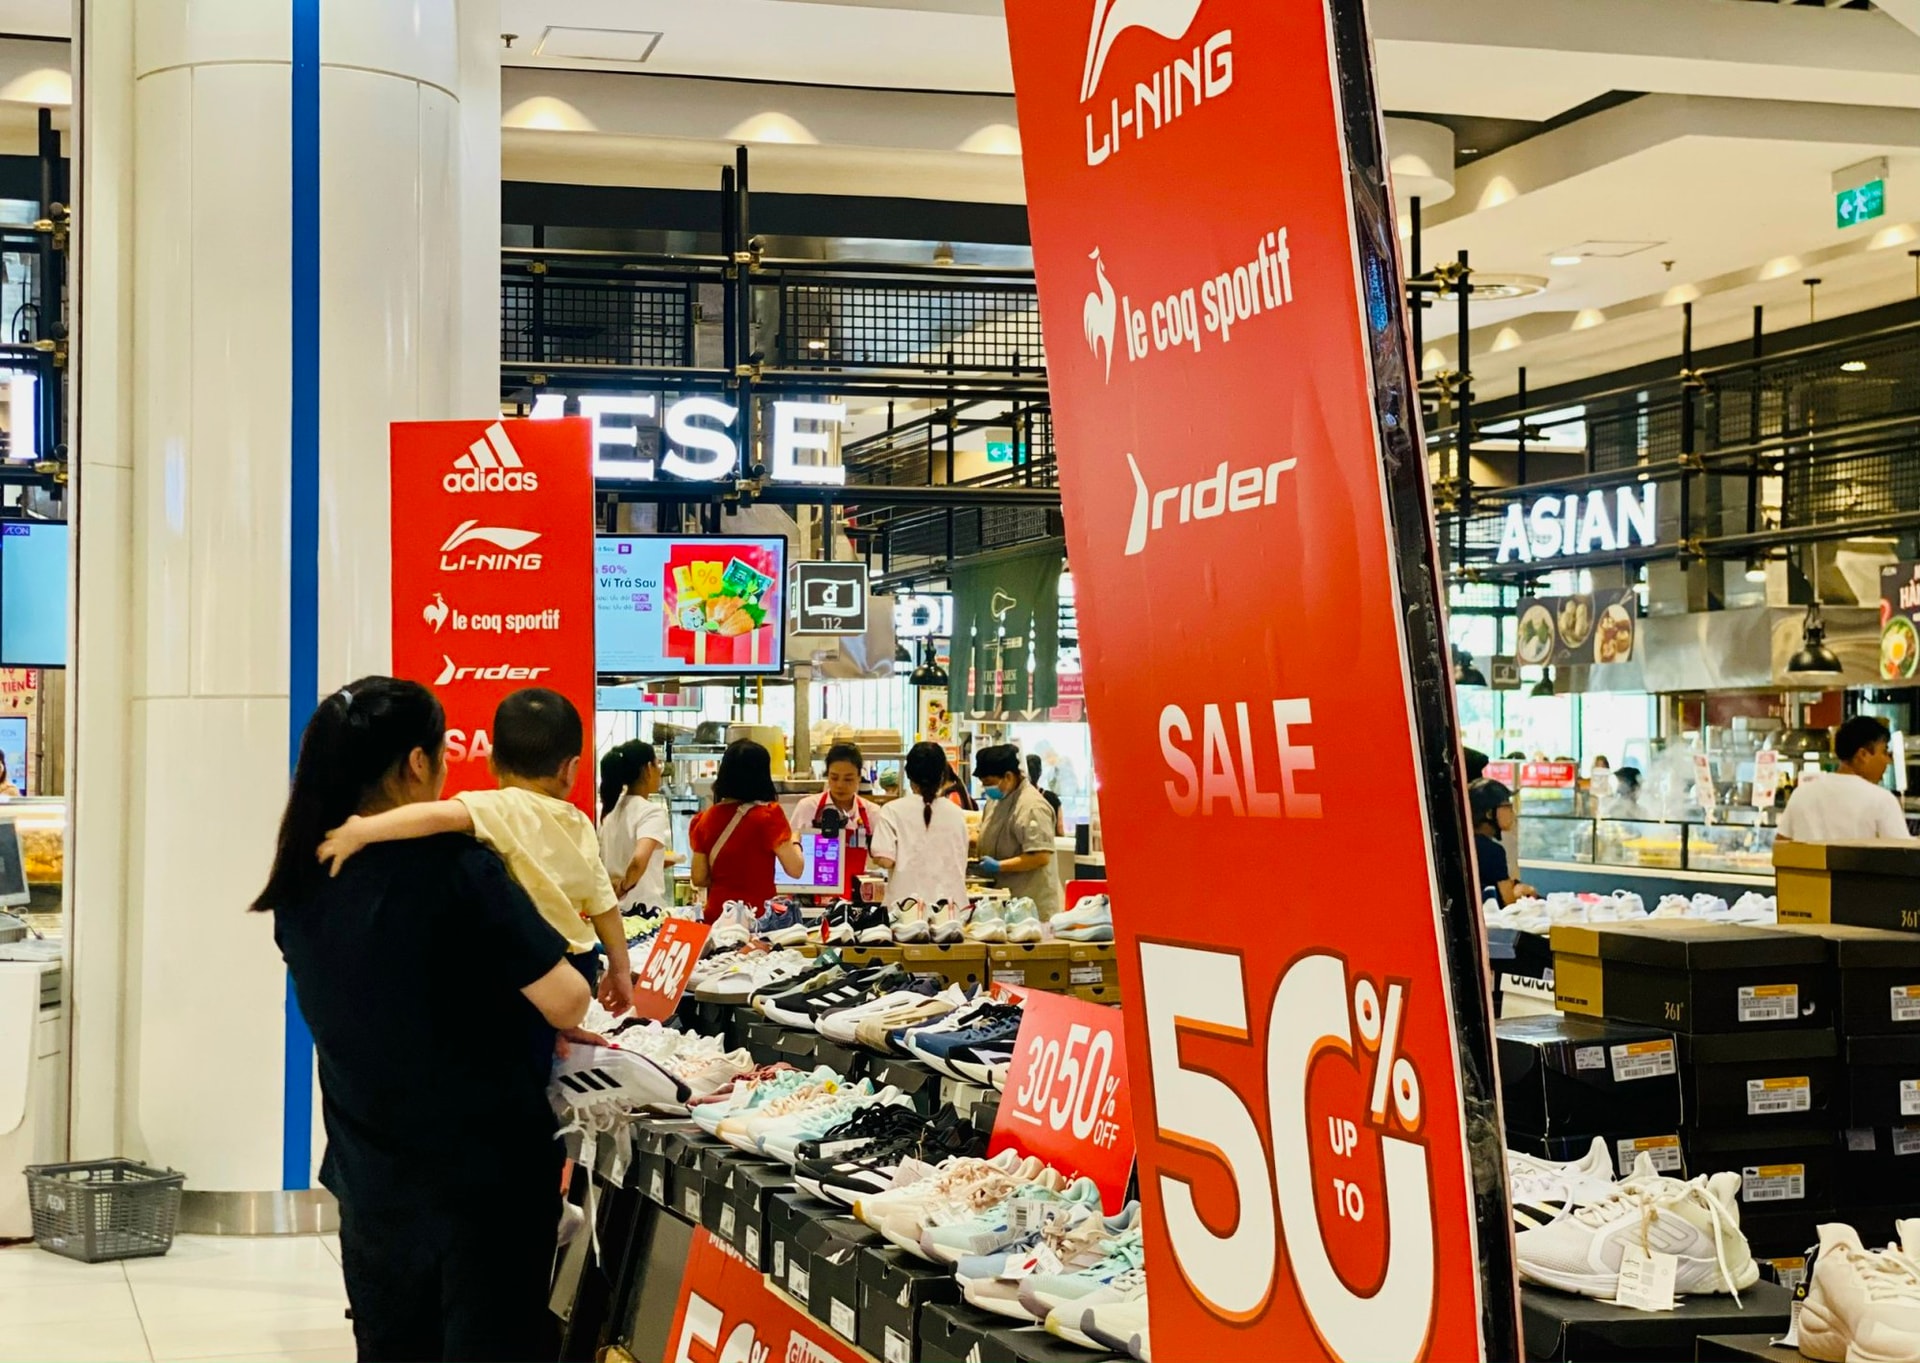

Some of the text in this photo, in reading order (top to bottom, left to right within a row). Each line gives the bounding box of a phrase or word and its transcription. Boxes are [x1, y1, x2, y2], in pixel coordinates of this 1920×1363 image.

[1086, 29, 1232, 166] LI-NING
[1122, 226, 1293, 362] le coq sportif
[526, 395, 846, 486] ESE
[443, 466, 538, 492] adidas
[1152, 457, 1297, 530] rider
[1496, 482, 1657, 563] ASIAN
[440, 553, 542, 571] LI-NING
[601, 565, 627, 574] 50%
[614, 577, 631, 588] Trả
[634, 578, 656, 588] Sau
[452, 609, 560, 633] le coq sportif
[821, 617, 843, 629] 112
[455, 664, 550, 679] rider
[1159, 697, 1323, 819] SALE
[1093, 1119, 1120, 1149] OFF
[1139, 941, 1433, 1363] 50%
[1328, 1116, 1358, 1158] UP
[1333, 1178, 1364, 1222] TO
